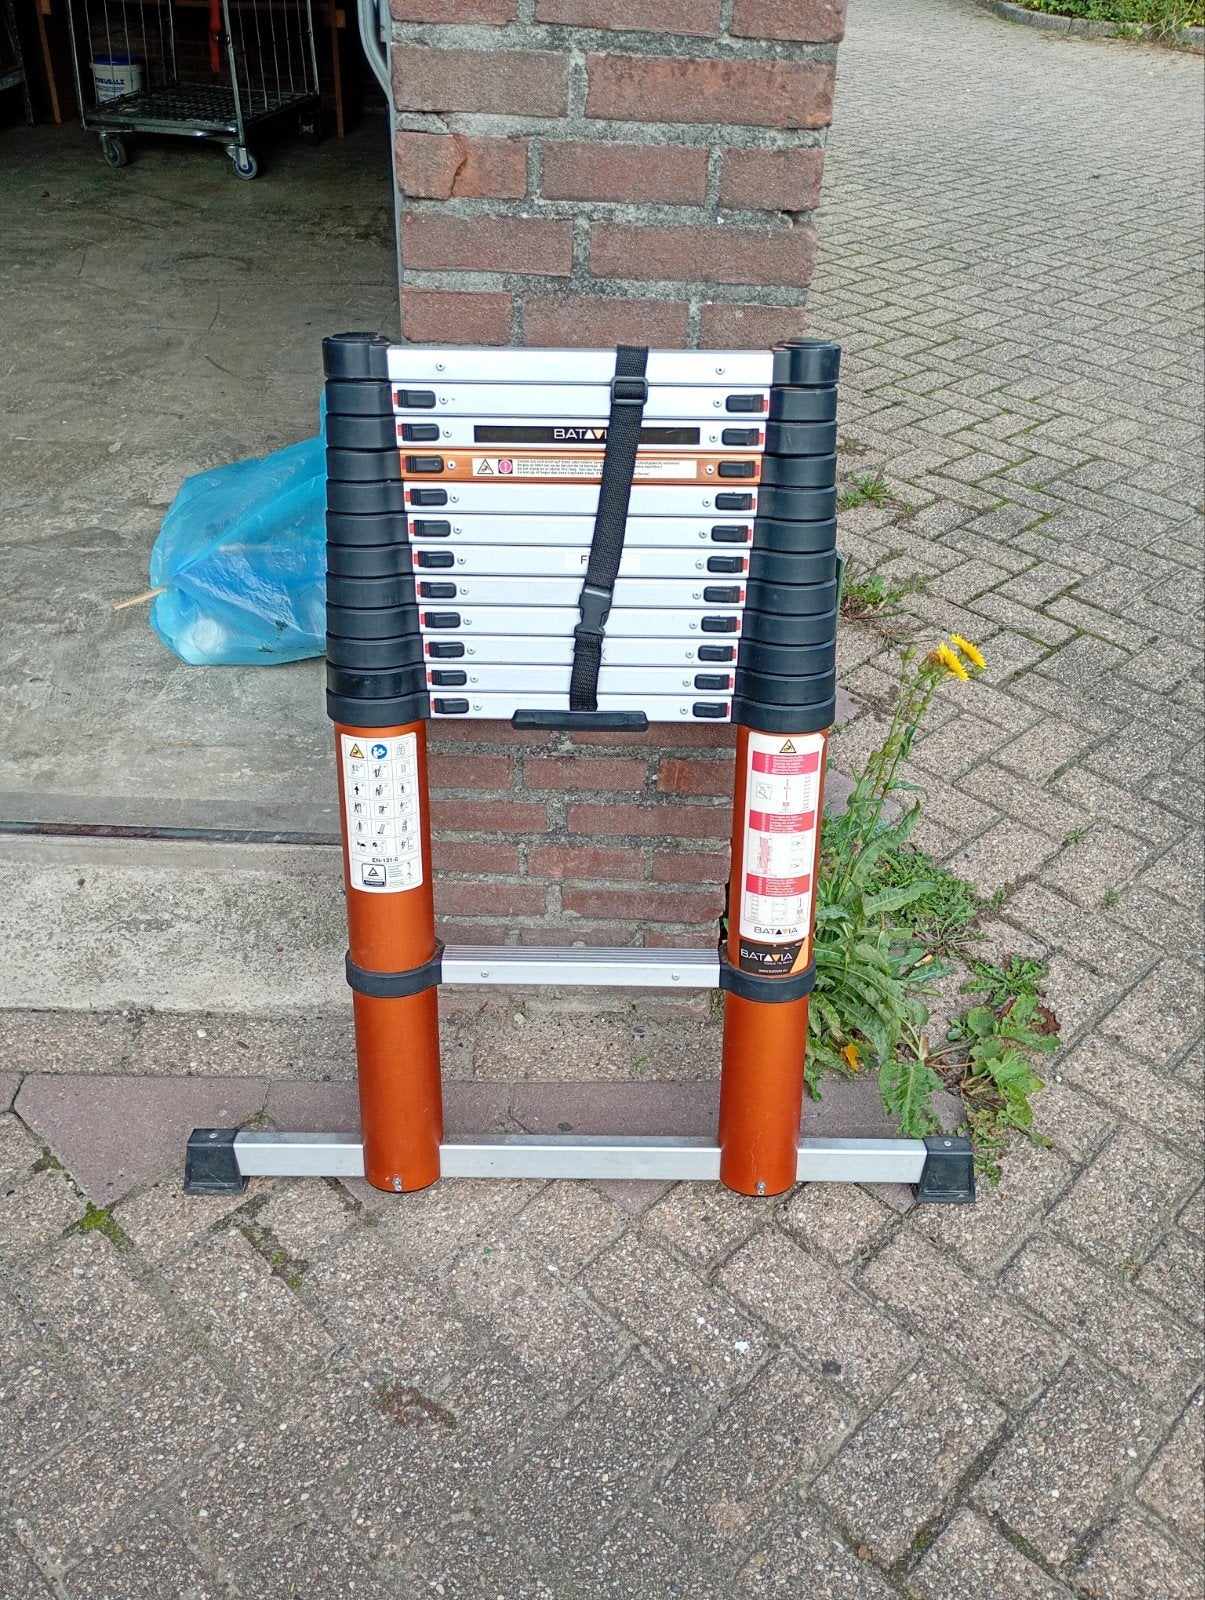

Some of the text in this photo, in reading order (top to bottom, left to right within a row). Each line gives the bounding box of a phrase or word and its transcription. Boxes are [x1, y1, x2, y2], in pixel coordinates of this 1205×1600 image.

[554, 428, 607, 440] BATAVI
[754, 926, 798, 934] BATAVIA
[740, 949, 793, 961] BATAVIA
